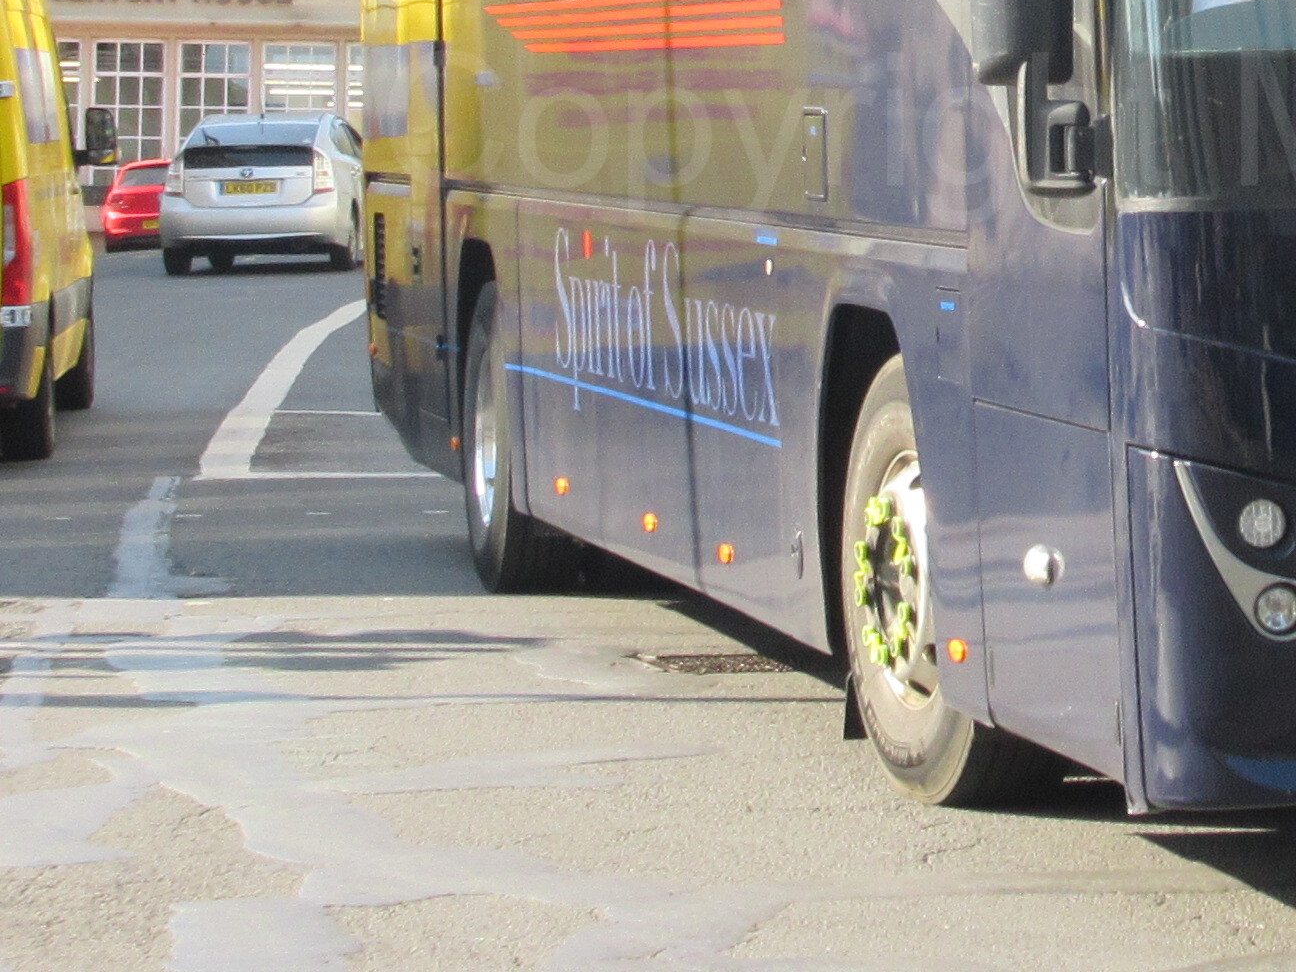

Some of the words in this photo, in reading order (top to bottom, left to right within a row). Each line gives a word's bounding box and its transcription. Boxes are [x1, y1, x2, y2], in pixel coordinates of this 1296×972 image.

[555, 227, 624, 411] Spirit
[628, 239, 656, 390] of
[663, 241, 780, 426] Sussex
